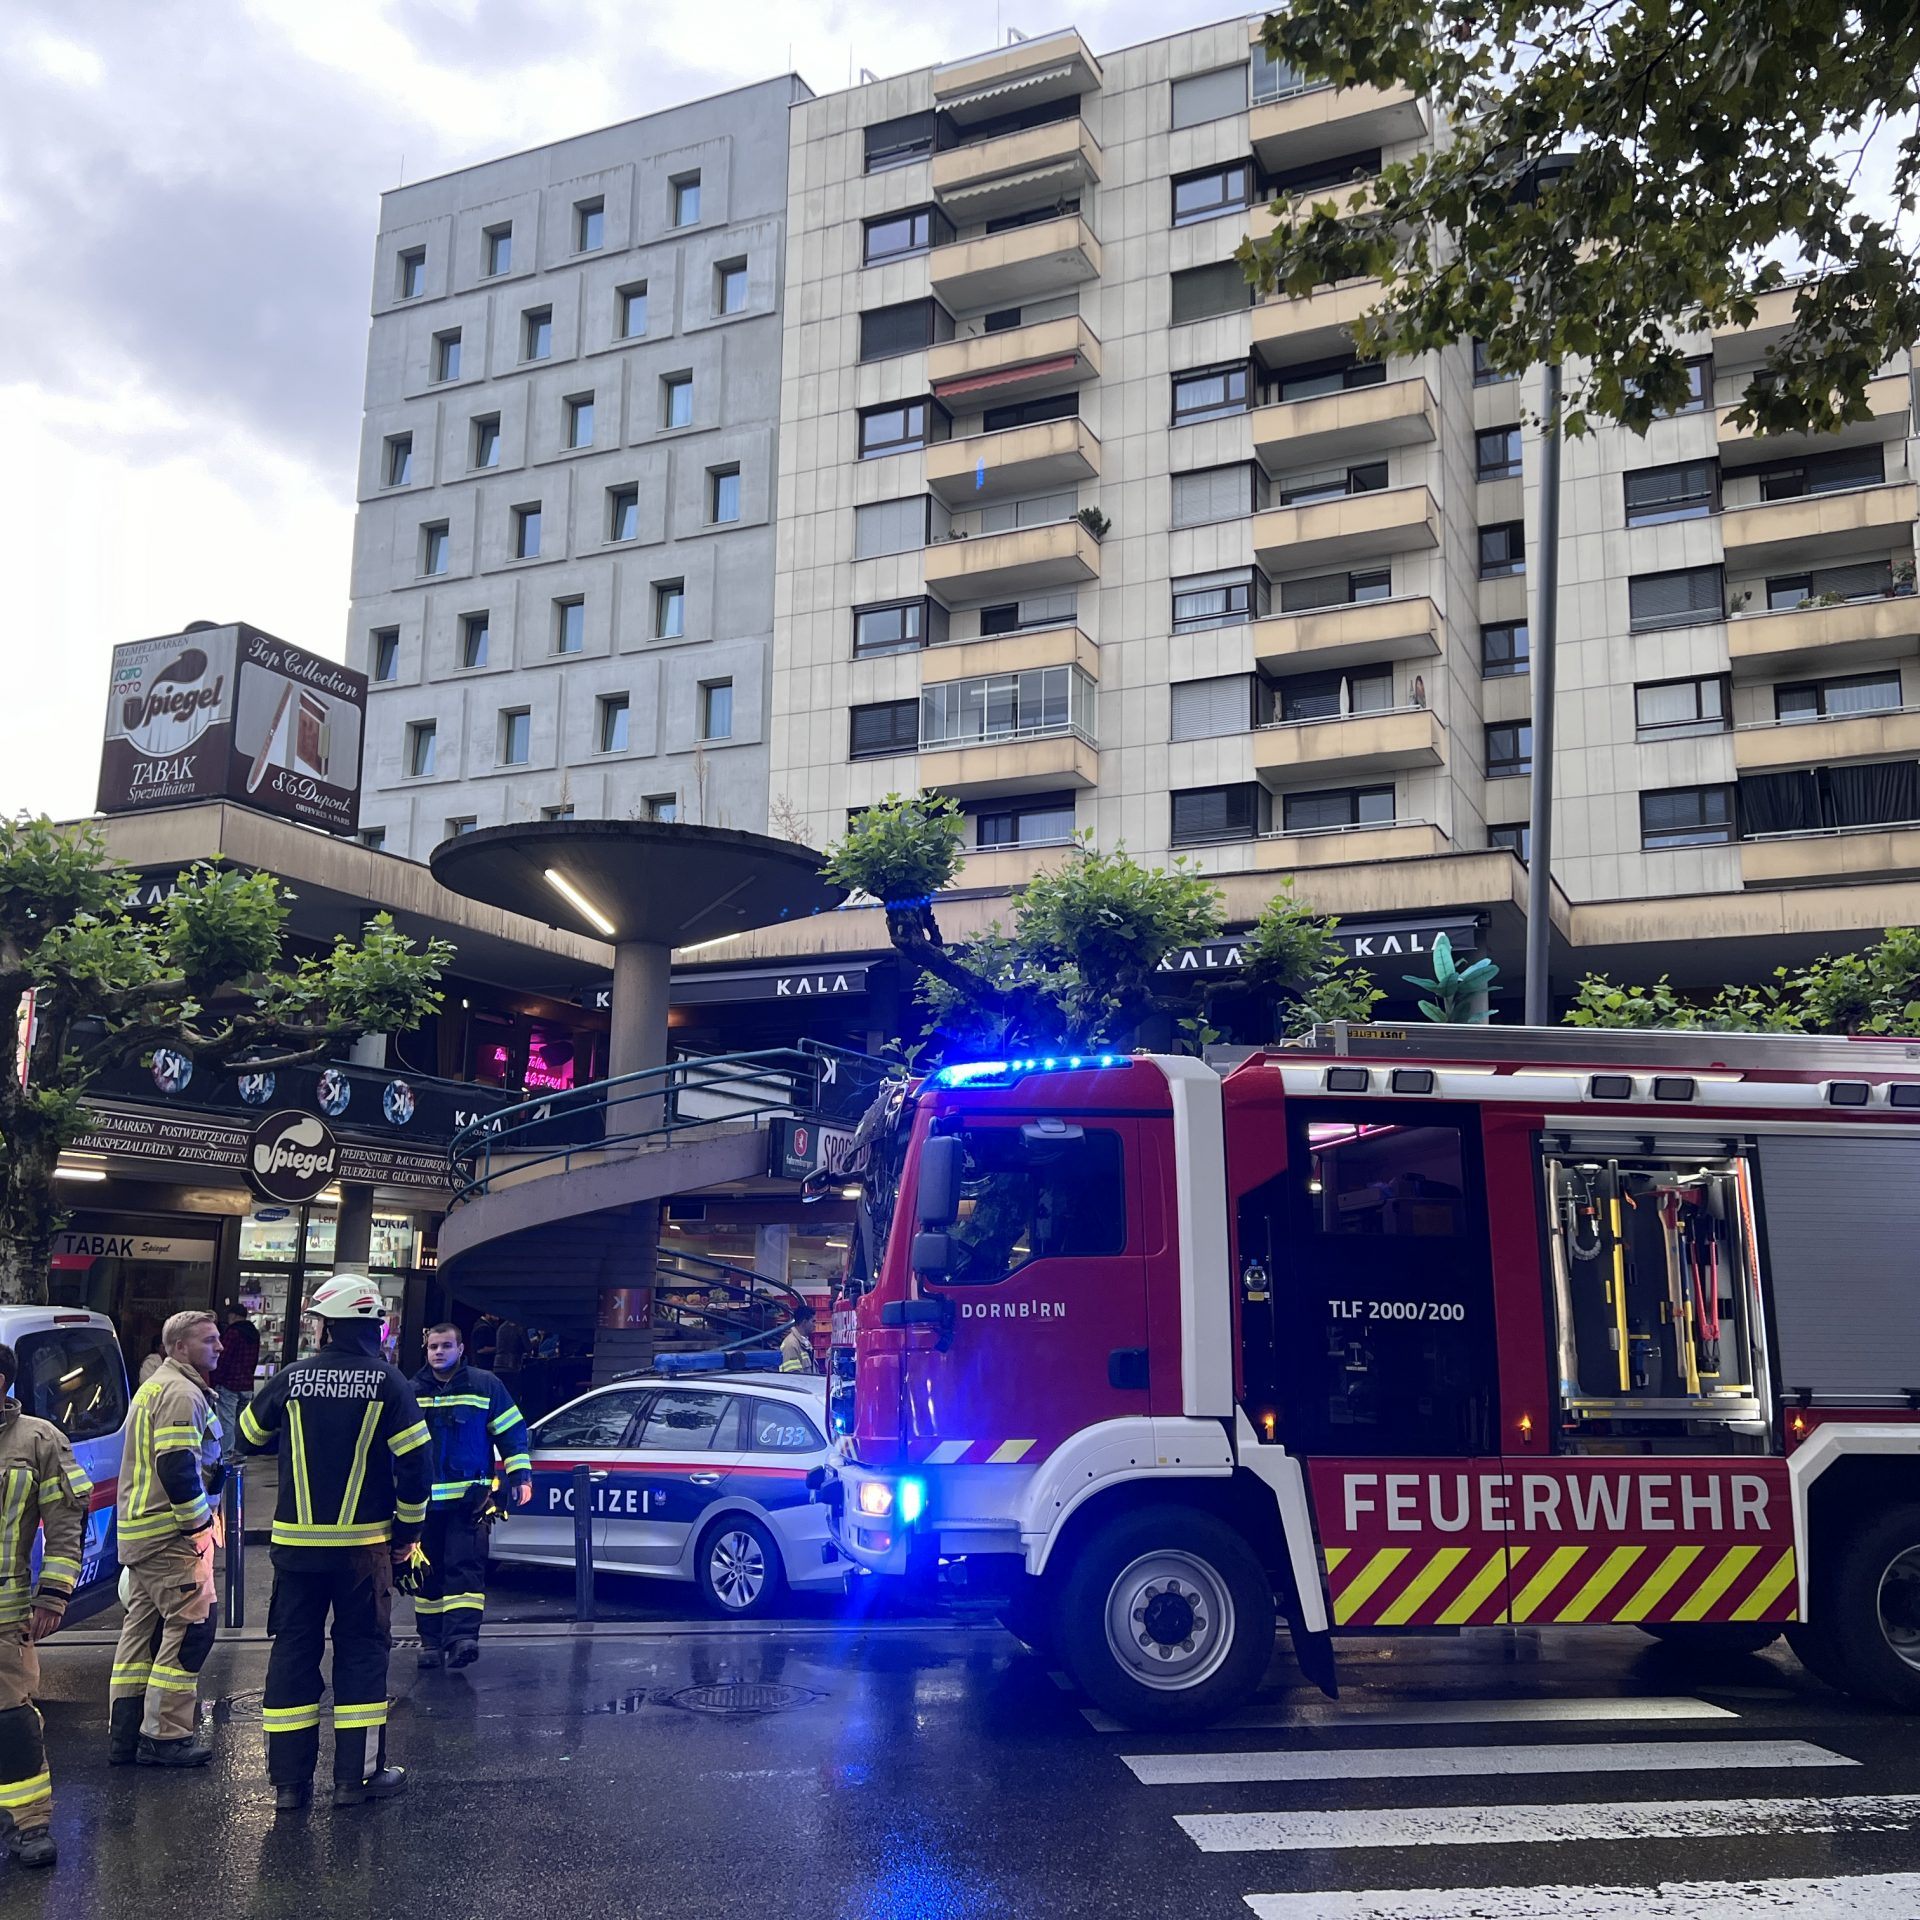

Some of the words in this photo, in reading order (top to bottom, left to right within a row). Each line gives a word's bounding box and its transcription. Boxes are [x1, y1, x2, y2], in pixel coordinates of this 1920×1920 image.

[116, 636, 190, 657] STEMPELMARKEN
[115, 654, 150, 668] BILLETS
[248, 636, 280, 668] Top
[283, 649, 358, 698] Collection
[112, 681, 142, 696] TOTO
[132, 755, 197, 786] TABAK
[127, 781, 196, 804] Spezialitäten
[776, 975, 849, 996] KALA
[1380, 1031, 1403, 1040] JUST
[158, 1124, 250, 1145] POSTWERTZEICHEN
[178, 1146, 248, 1164] ZEITSCHRIFTEN
[253, 1118, 336, 1179] Spiegel
[340, 1148, 394, 1164] PFEIFENSTUBE
[338, 1165, 389, 1180] FEUERZEUGE
[63, 1234, 134, 1257] TABAK
[140, 1241, 171, 1255] Spiegel
[961, 1299, 1067, 1318] DORNBIRN
[1328, 1300, 1363, 1318] TLF
[1368, 1301, 1465, 1321] 2000/200
[288, 1369, 387, 1387] FEUERWEHR
[290, 1383, 378, 1399] DORNBIRN
[776, 1426, 806, 1446] 133
[549, 1487, 649, 1514] POIZEI
[1343, 1473, 1771, 1532] FEUERWEHR
